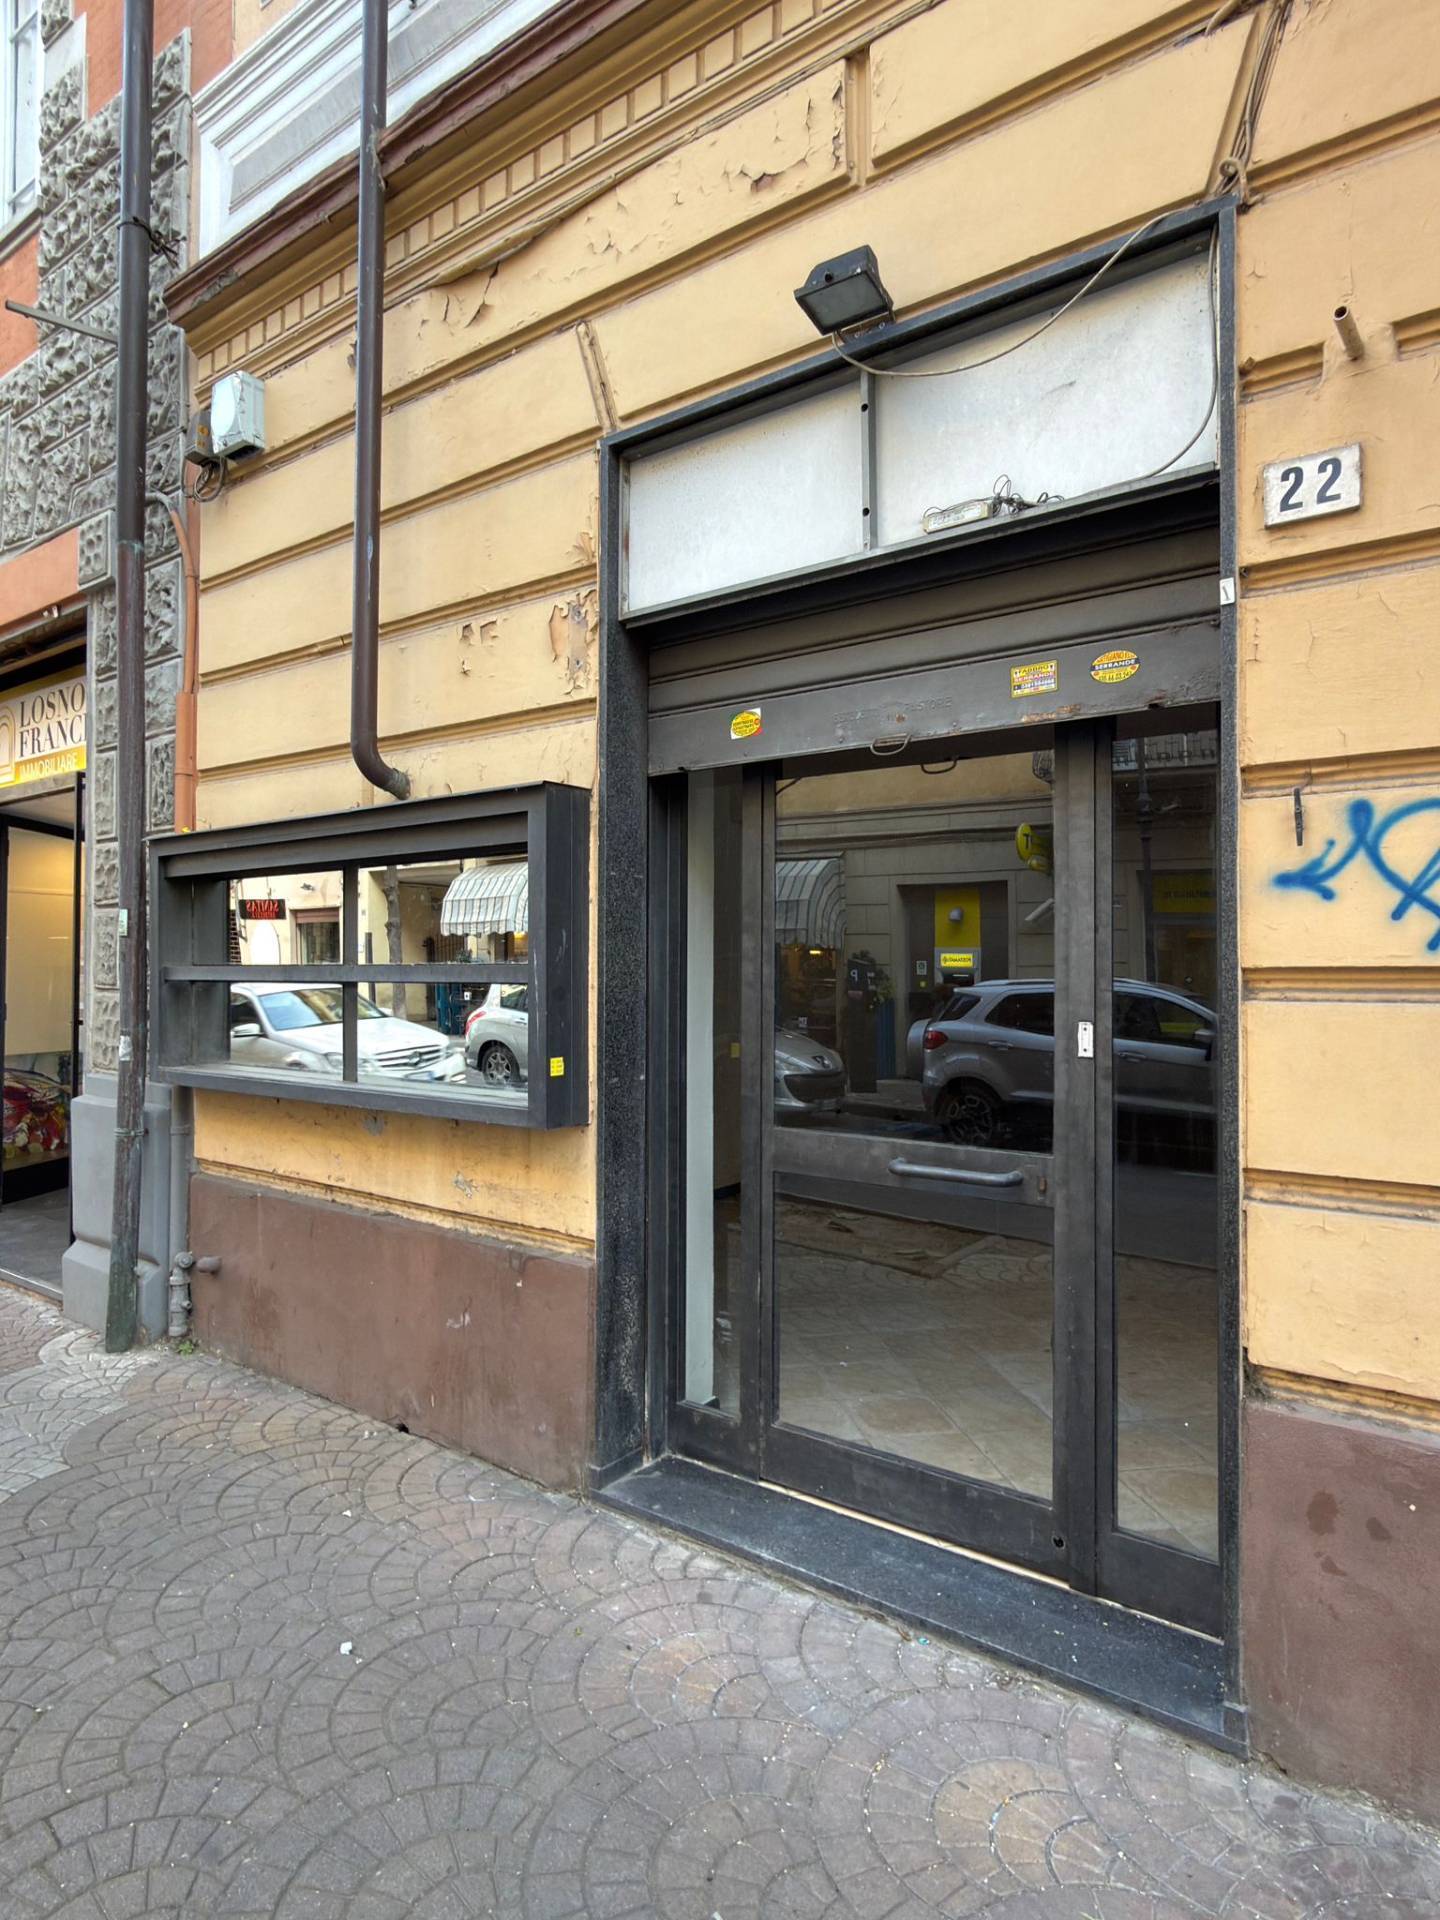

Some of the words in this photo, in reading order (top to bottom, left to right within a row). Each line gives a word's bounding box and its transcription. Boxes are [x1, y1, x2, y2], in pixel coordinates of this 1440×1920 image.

[1280, 457, 1342, 513] 22
[20, 683, 85, 728] LOSNO
[19, 752, 78, 779] IMMOBILIARE
